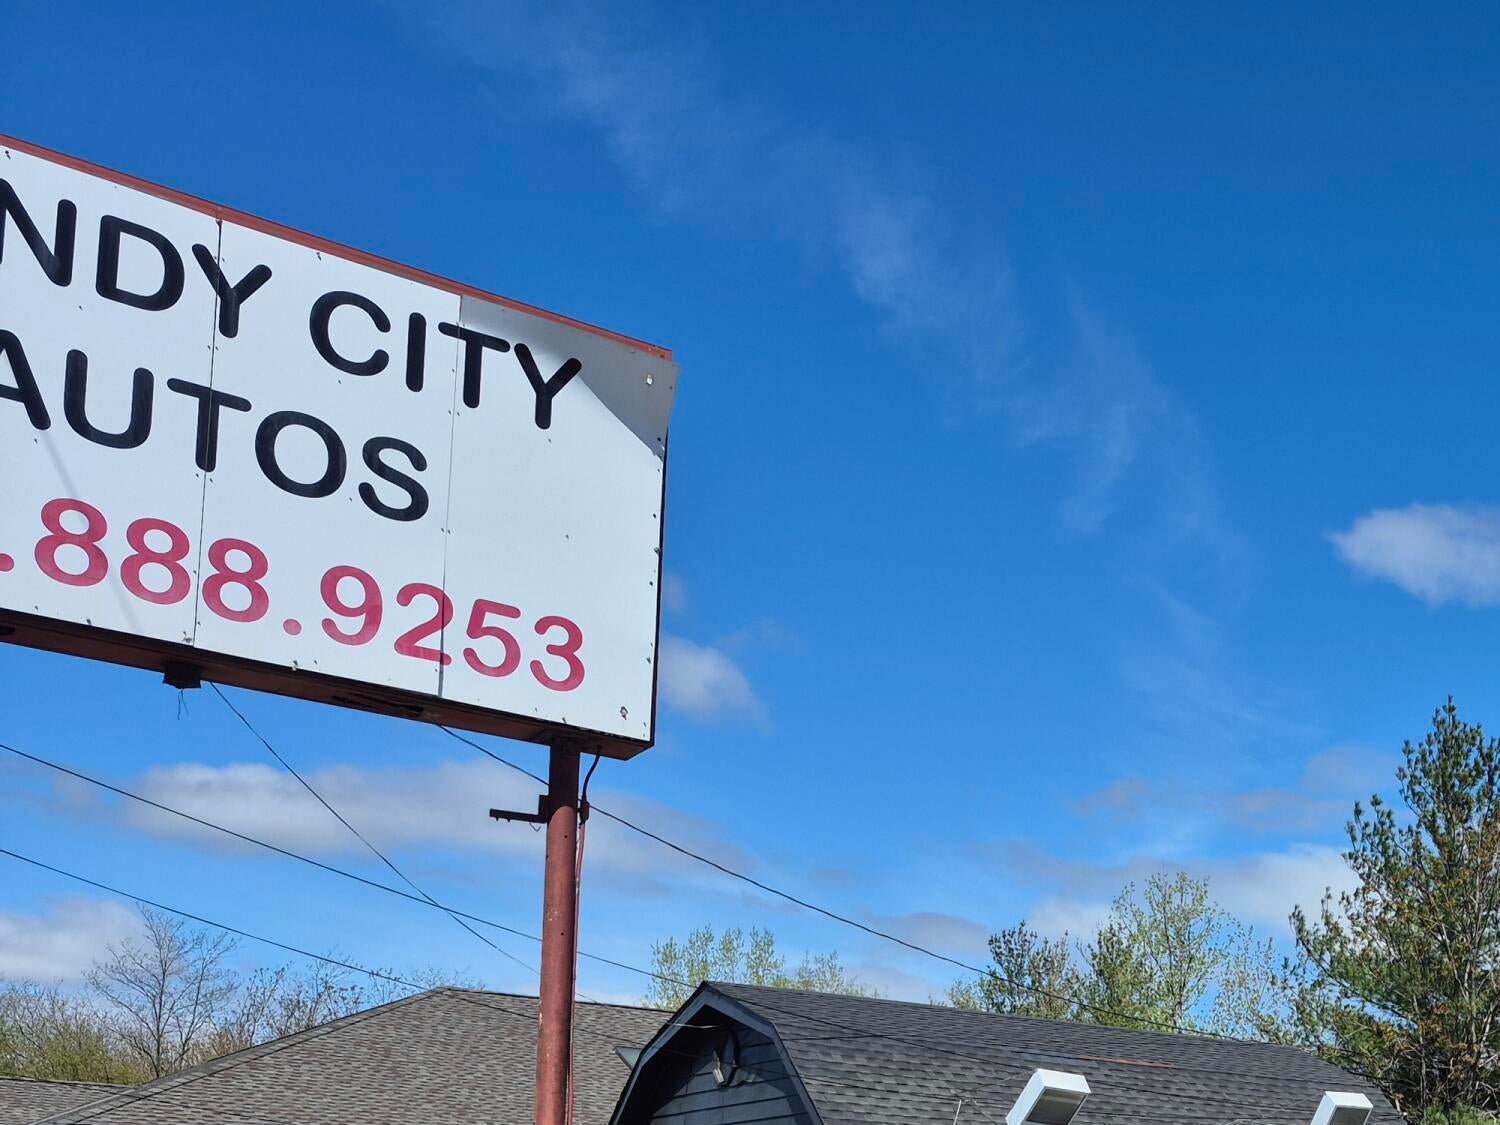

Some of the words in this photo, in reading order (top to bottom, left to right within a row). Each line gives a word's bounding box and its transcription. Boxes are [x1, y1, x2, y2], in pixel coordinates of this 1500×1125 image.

[0, 178, 272, 338] NDY
[309, 291, 582, 430] CITY
[0, 329, 429, 522] AUTOS
